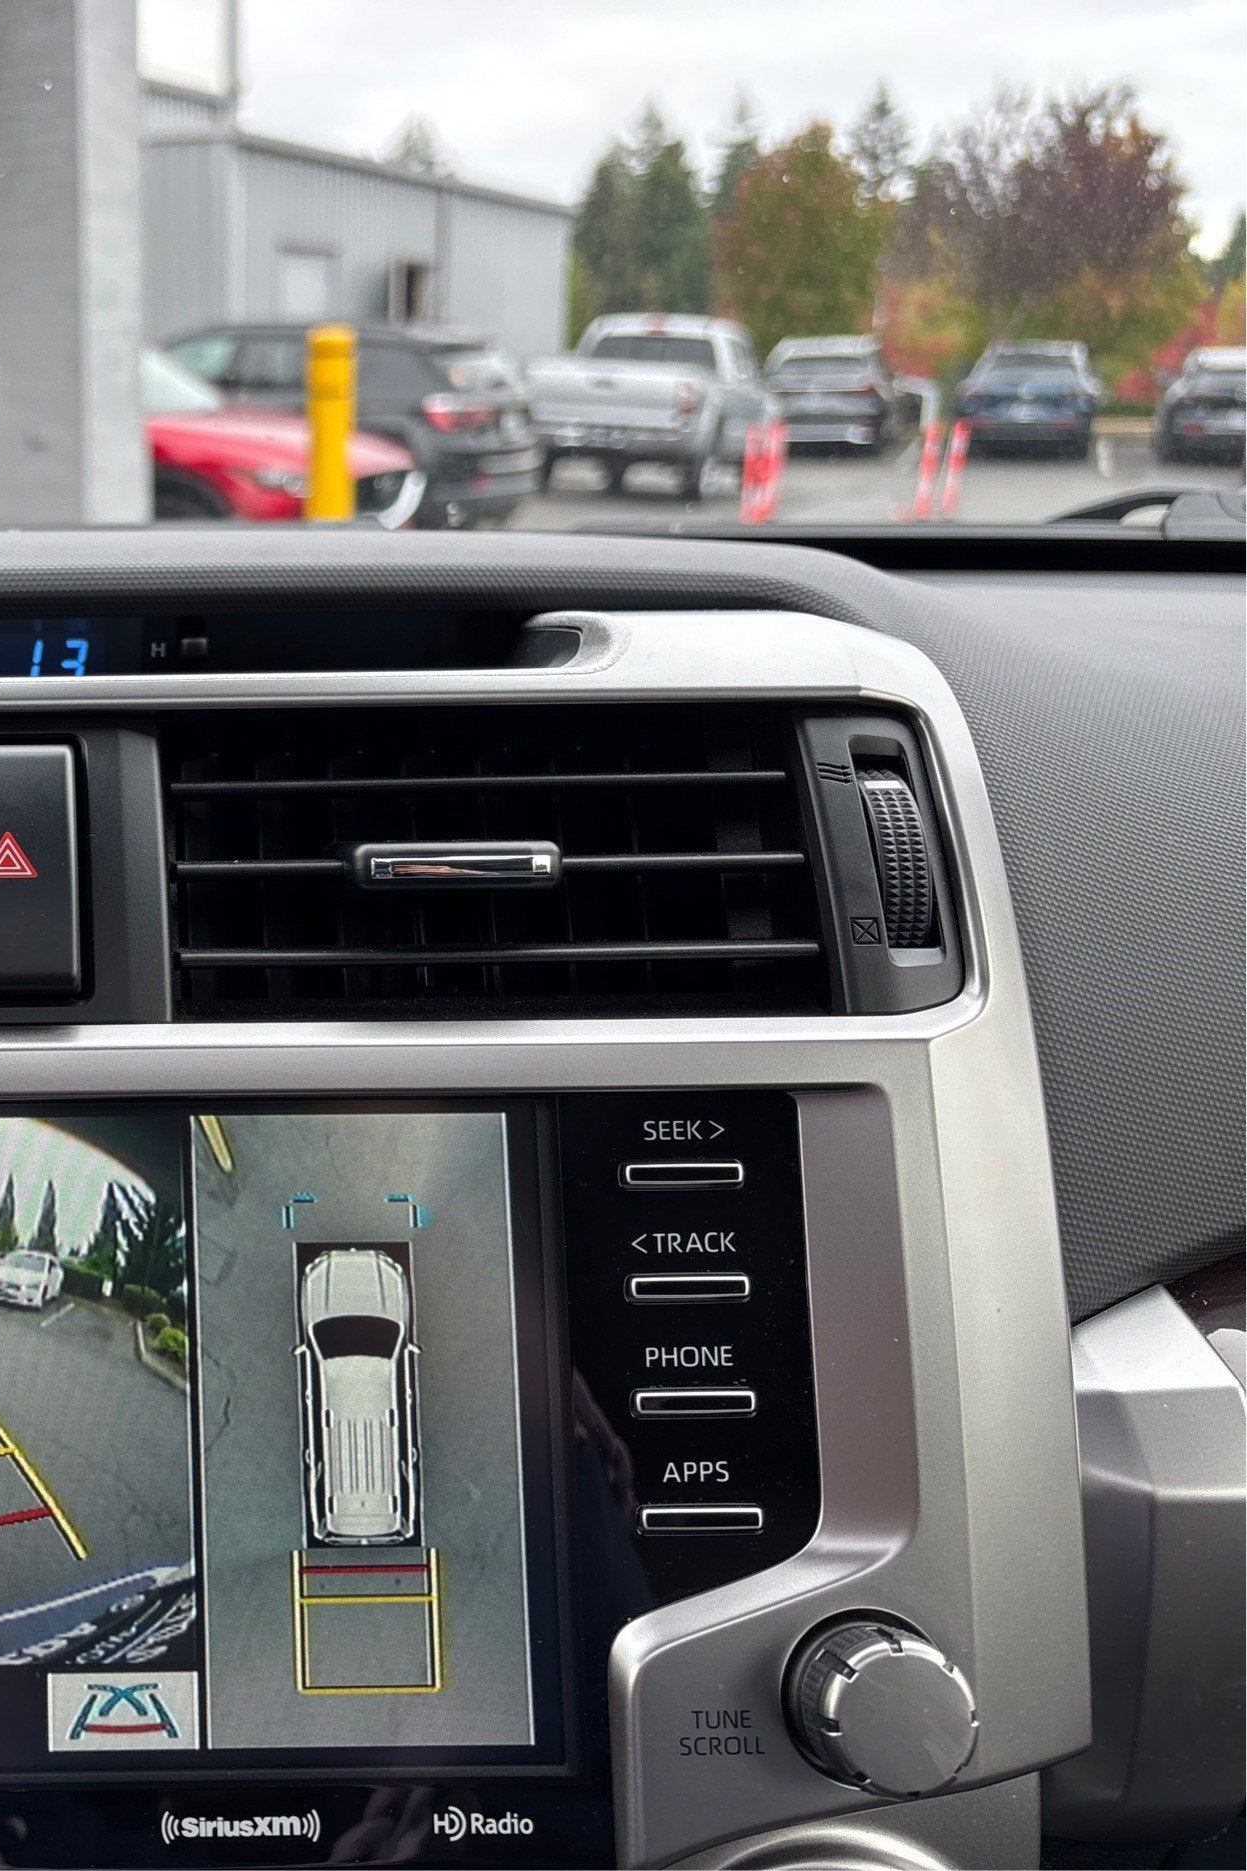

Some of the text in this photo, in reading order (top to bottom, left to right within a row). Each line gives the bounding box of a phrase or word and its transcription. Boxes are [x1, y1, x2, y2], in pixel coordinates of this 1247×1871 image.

[645, 1346, 734, 1368] PHONE
[662, 1461, 730, 1483] APPS
[691, 1709, 752, 1730] TUNE
[679, 1736, 765, 1757] SCROLL
[433, 1808, 534, 1840] HD Radio
